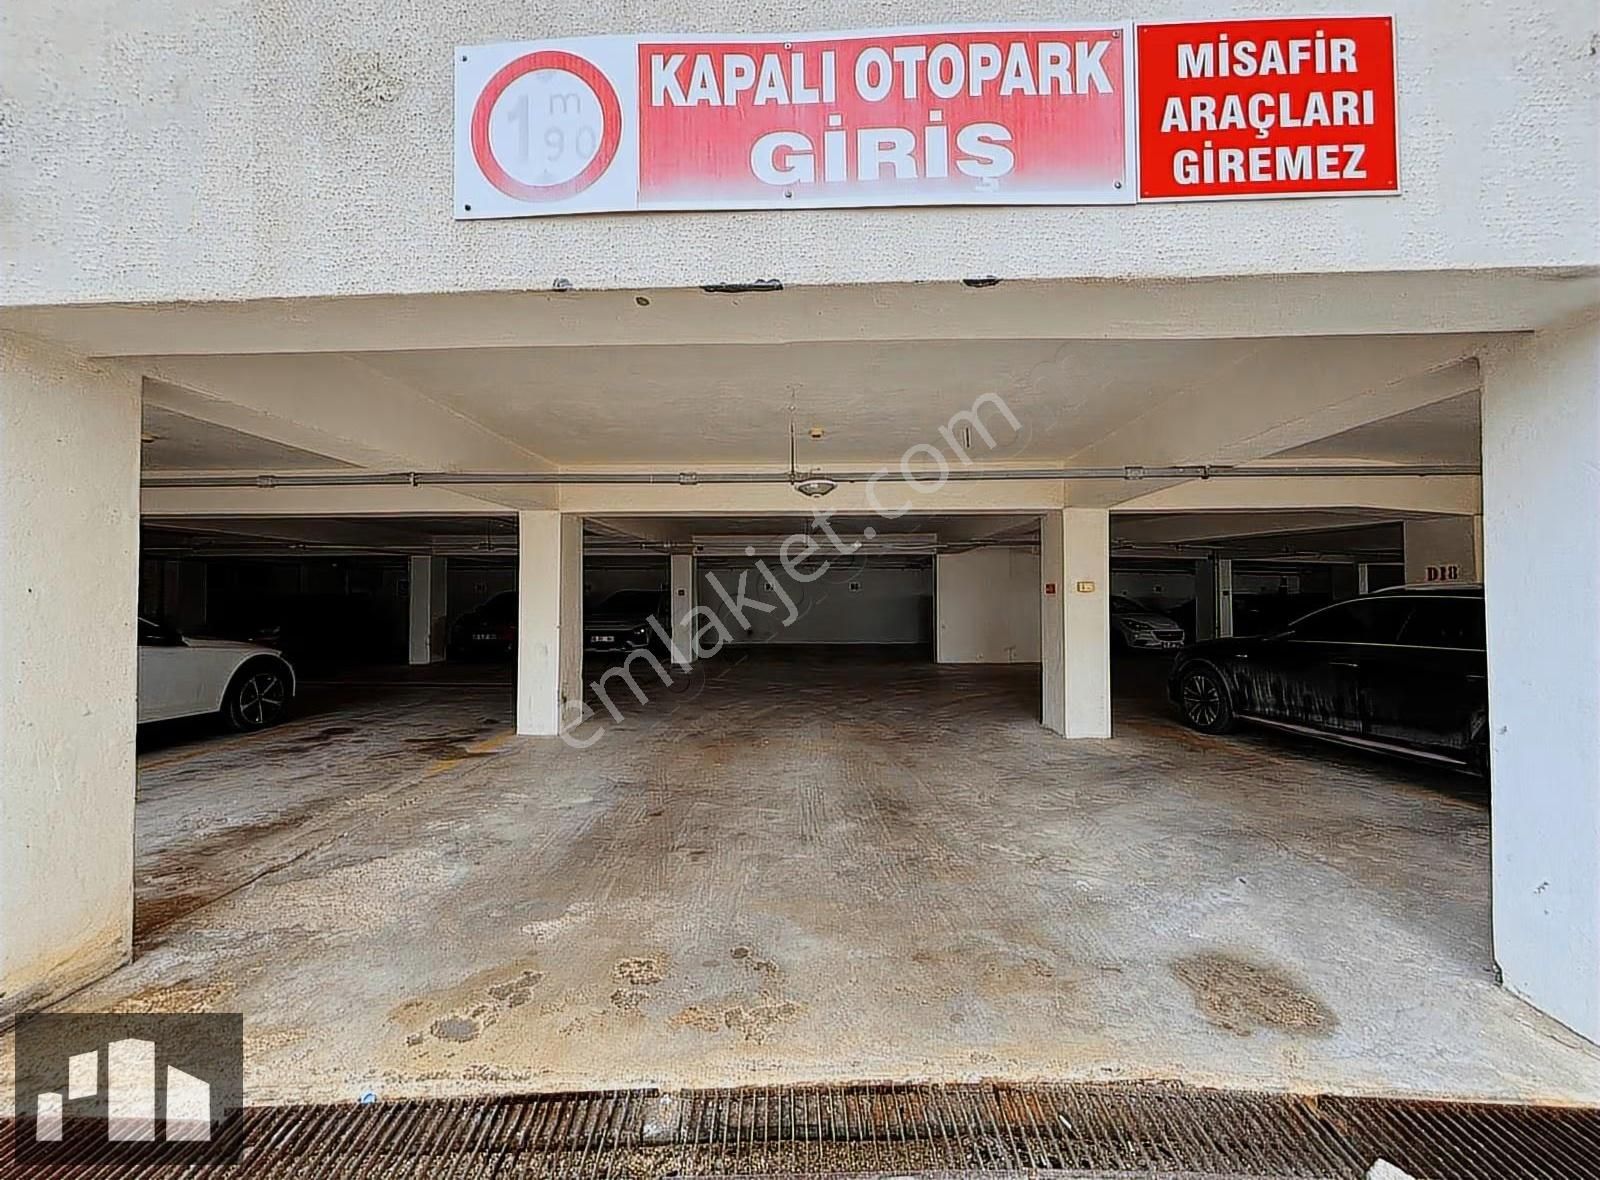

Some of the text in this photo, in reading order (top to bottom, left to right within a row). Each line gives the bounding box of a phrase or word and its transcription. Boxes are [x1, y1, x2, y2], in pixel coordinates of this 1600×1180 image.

[651, 41, 1114, 107] KAPALI OTOPARK
[1177, 30, 1359, 79] MİSAFİR
[1160, 90, 1375, 139] ARAÇLARI
[749, 110, 1016, 192] GİRİŞ
[1173, 140, 1368, 185] GİREMEZ
